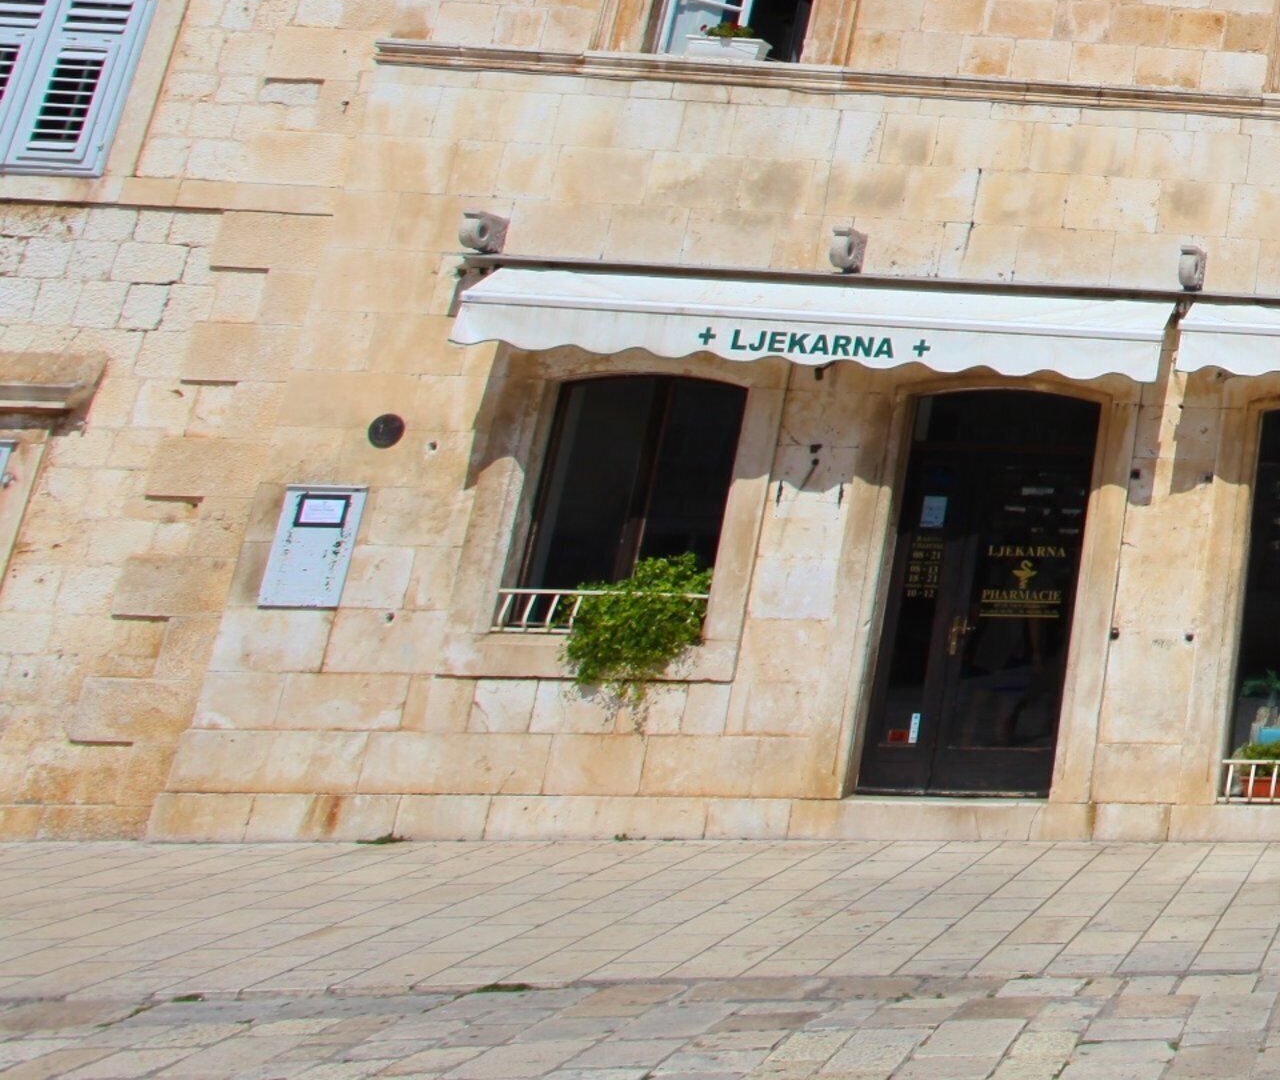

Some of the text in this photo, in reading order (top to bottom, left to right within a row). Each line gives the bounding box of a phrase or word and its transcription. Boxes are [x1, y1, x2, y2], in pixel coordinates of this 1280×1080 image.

[730, 329, 894, 358] LJEKARNA
[988, 545, 1066, 558] LJEKARNA
[982, 589, 1061, 600] PHARMACIE
